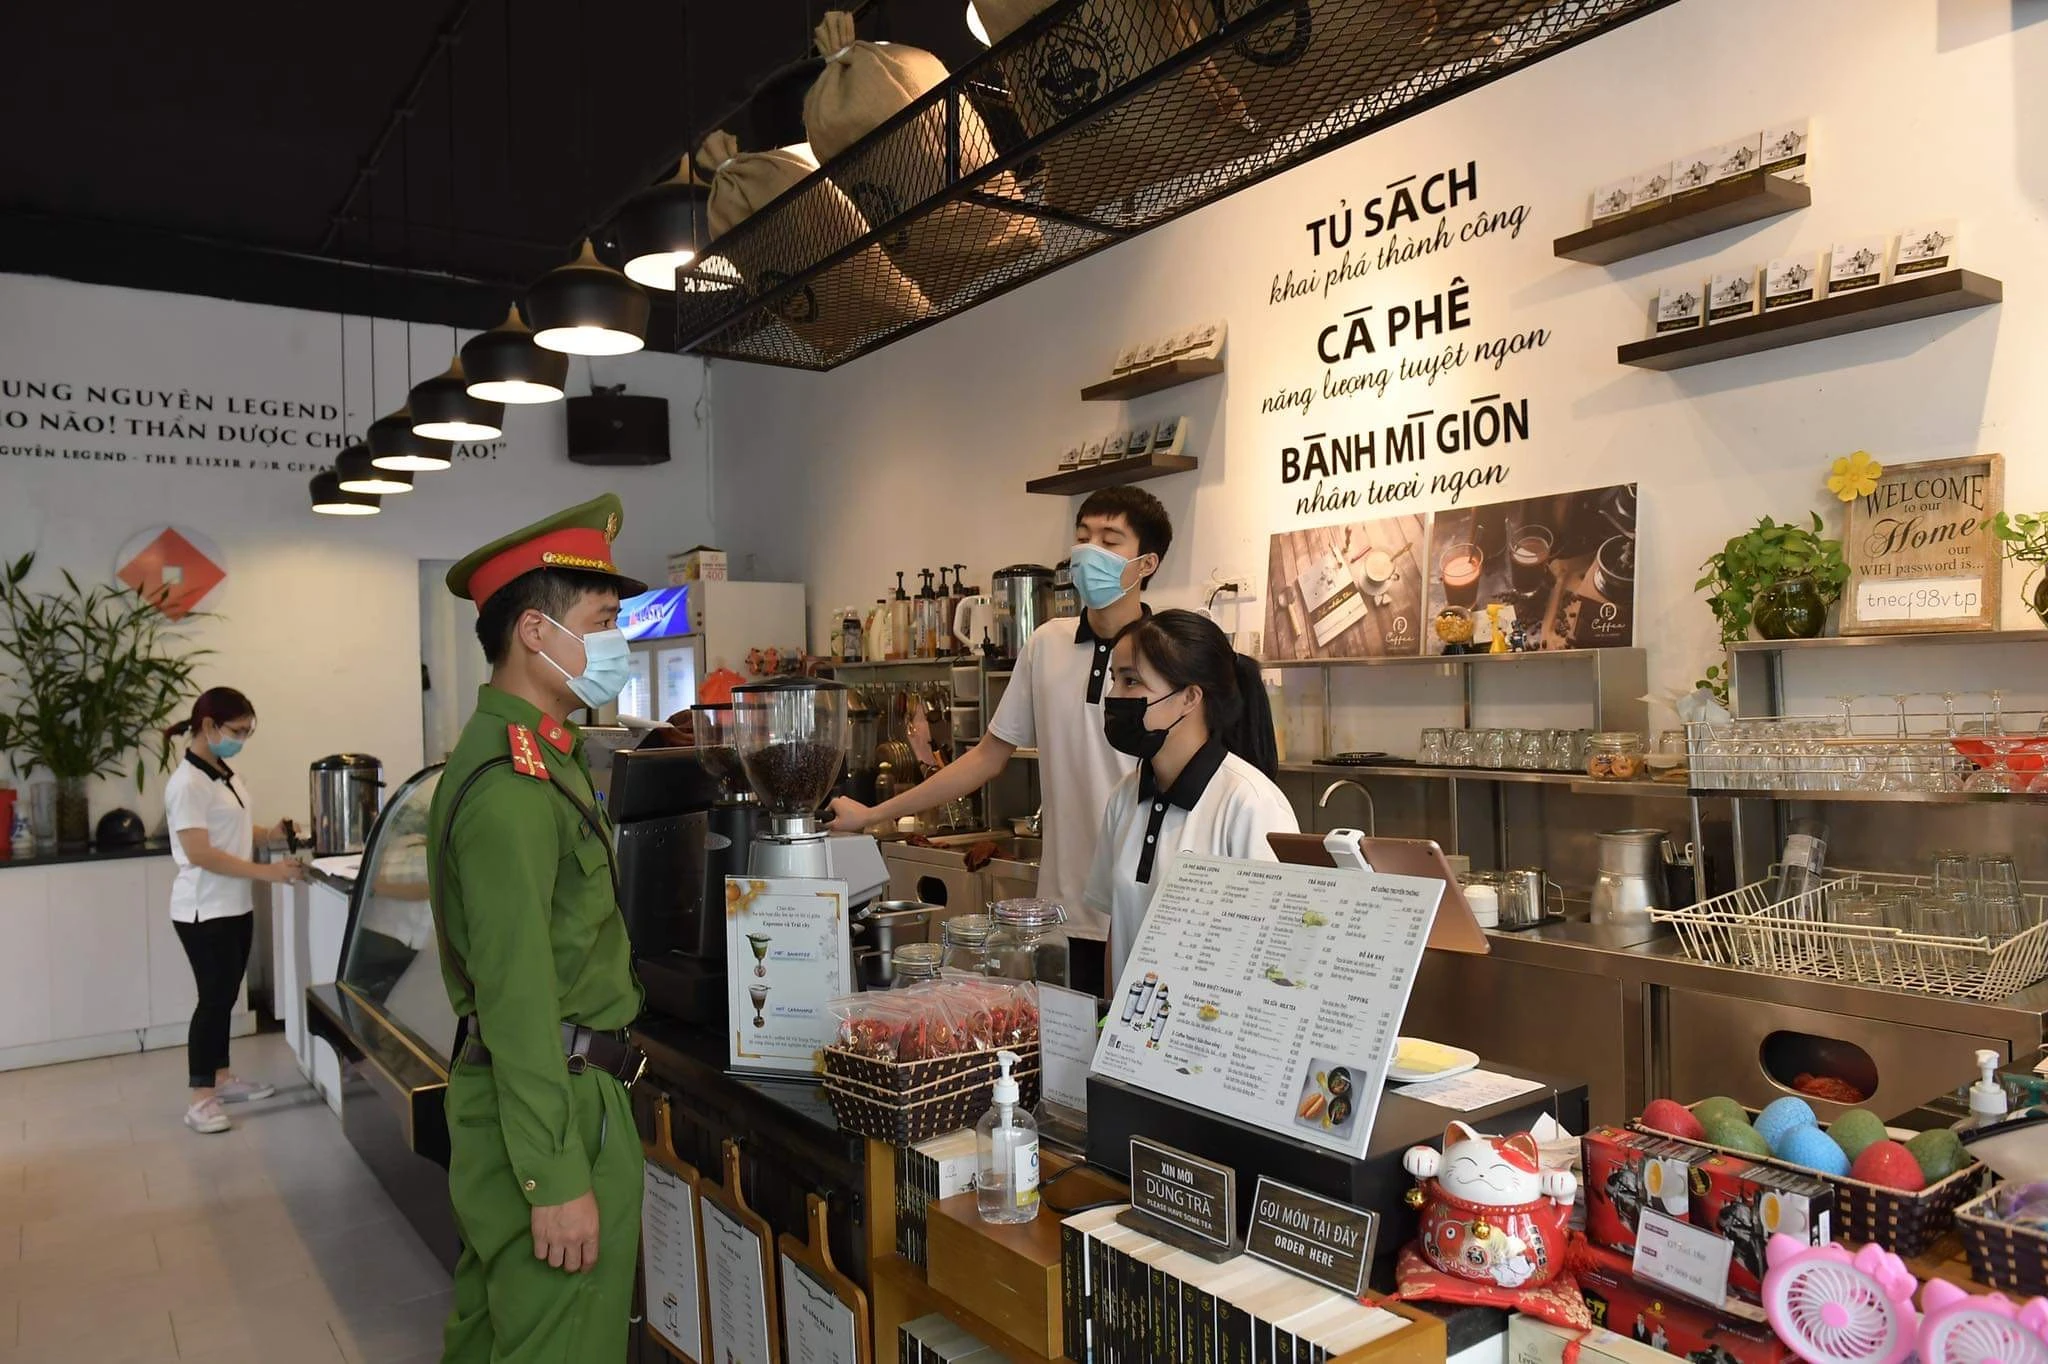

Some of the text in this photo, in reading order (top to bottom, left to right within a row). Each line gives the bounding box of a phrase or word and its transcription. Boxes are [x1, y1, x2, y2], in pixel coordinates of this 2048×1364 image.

[1306, 200, 1351, 256] TỦ
[1269, 203, 1532, 306] khai phá thành công
[1388, 277, 1471, 347] PHÊ
[1261, 327, 1552, 416] năng lượng tuyệt ngon
[87, 387, 214, 411] NGUYÊN
[228, 397, 337, 420] LEGEND
[0, 410, 28, 429] O
[40, 411, 116, 434] NÃO!
[218, 424, 297, 448] DƯỢC
[306, 431, 362, 450] CHO
[63, 449, 127, 462] LEGEND
[145, 453, 177, 465] THE
[186, 456, 241, 469] ELIXIR
[1296, 463, 1510, 516] nhân tươi ngon
[1865, 474, 1985, 519] WELCOME
[1904, 502, 1941, 513] to our
[1863, 516, 1978, 559] Home
[1948, 544, 1971, 556] our
[1859, 563, 1891, 576] WIFI
[1896, 558, 1957, 576] password
[1161, 1161, 1176, 1179] XIN
[1146, 1177, 1212, 1218] DÙNG TRÀ
[1146, 1198, 1213, 1231] PLEASE HAVE SOME TEA
[1259, 1199, 1280, 1222] GỌI
[1281, 1207, 1310, 1232] MÓN
[1312, 1216, 1331, 1241] TẠI
[1274, 1234, 1335, 1268] ORDER HERE
